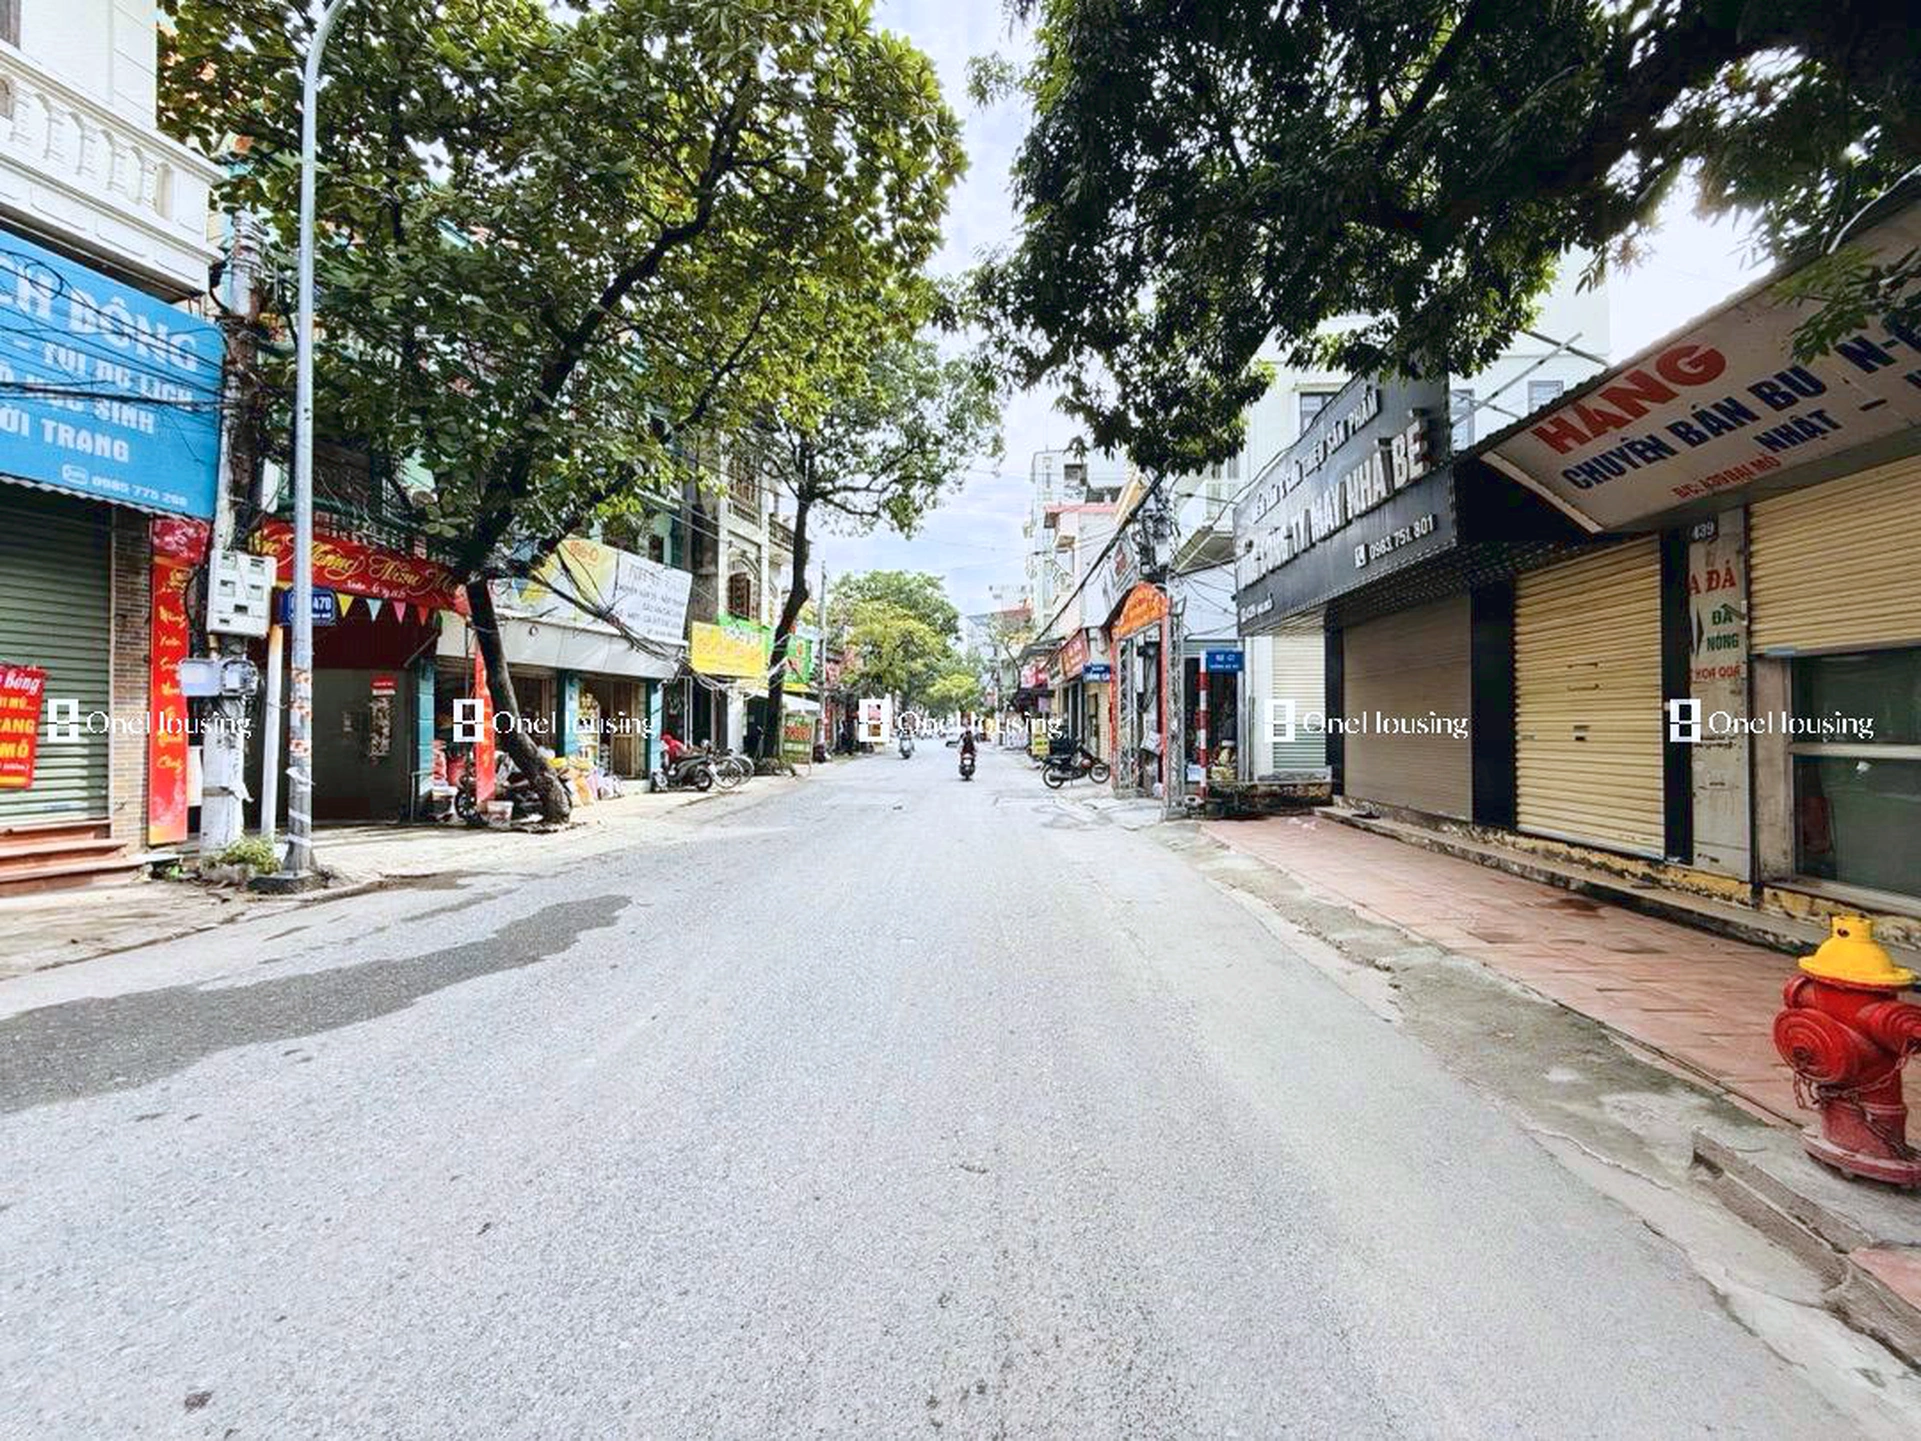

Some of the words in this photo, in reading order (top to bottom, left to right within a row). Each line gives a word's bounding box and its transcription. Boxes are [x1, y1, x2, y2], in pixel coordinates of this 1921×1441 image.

[41, 417, 130, 463] TRANG
[1561, 431, 1680, 490] CHUYÊN
[1666, 396, 1761, 448] BÁN
[1753, 409, 1842, 453] NHẬT
[1311, 480, 1341, 543] MAY
[1345, 436, 1388, 521] NHÀ
